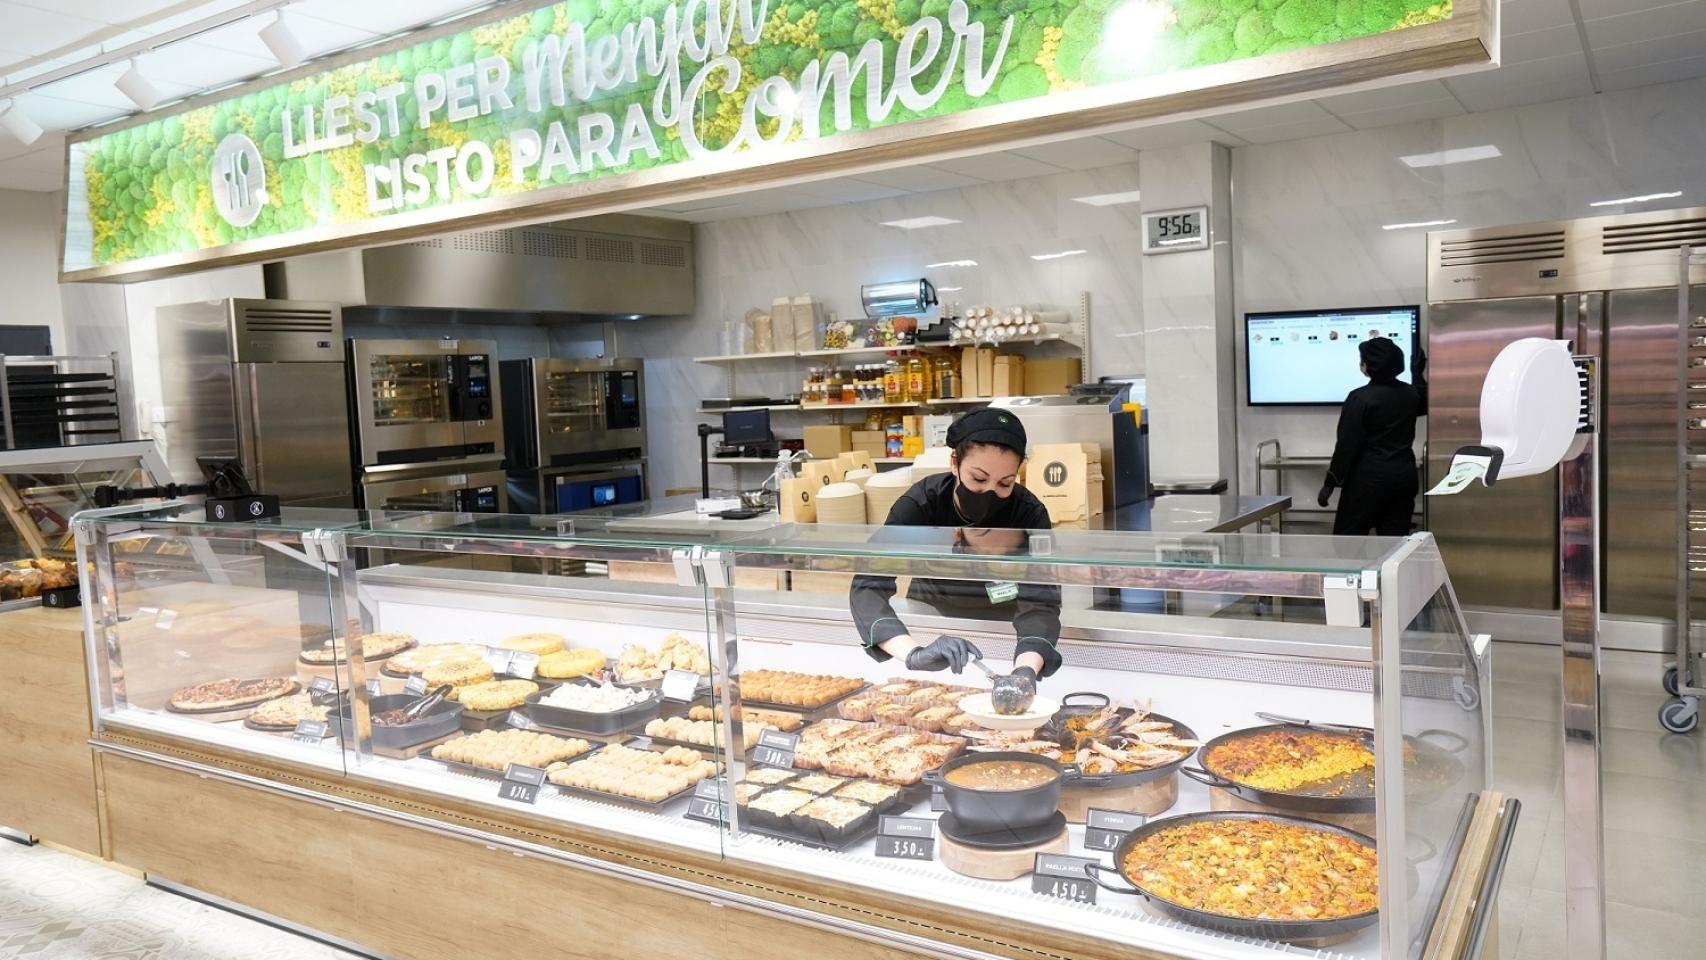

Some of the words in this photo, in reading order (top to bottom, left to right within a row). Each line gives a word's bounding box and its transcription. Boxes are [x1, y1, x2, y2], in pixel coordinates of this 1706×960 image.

[281, 83, 406, 159] LLEST
[414, 55, 514, 129] PER
[364, 140, 495, 213] LISTO
[510, 103, 661, 185] PARA
[679, 0, 1014, 159] Comer
[1159, 214, 1192, 237] 9:56
